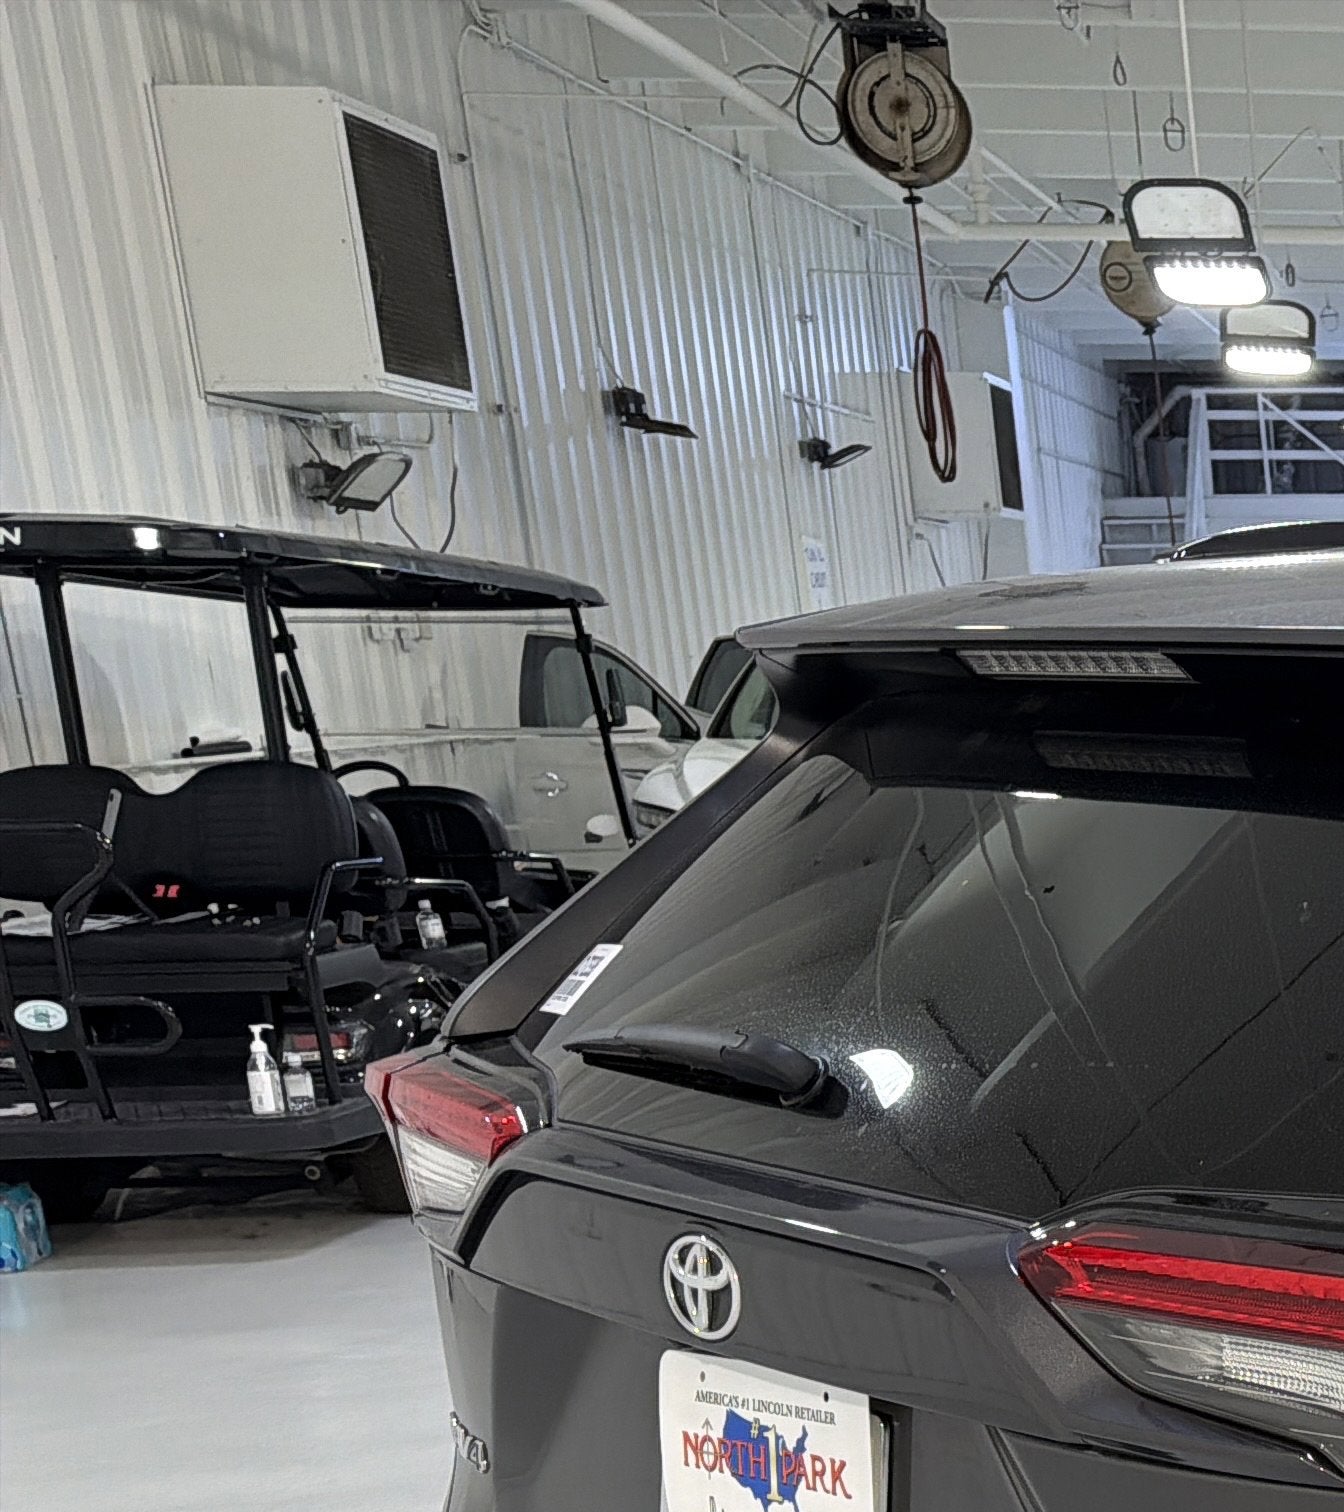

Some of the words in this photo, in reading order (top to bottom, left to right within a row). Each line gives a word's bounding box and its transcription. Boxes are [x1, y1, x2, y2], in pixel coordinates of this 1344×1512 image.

[694, 1389, 740, 1408] AMERICA'S
[741, 1397, 750, 1411] #1
[752, 1398, 793, 1418] LINCOLN
[794, 1405, 837, 1426] RETAILER
[682, 1430, 768, 1481] NORTH
[782, 1451, 853, 1500] PARK
